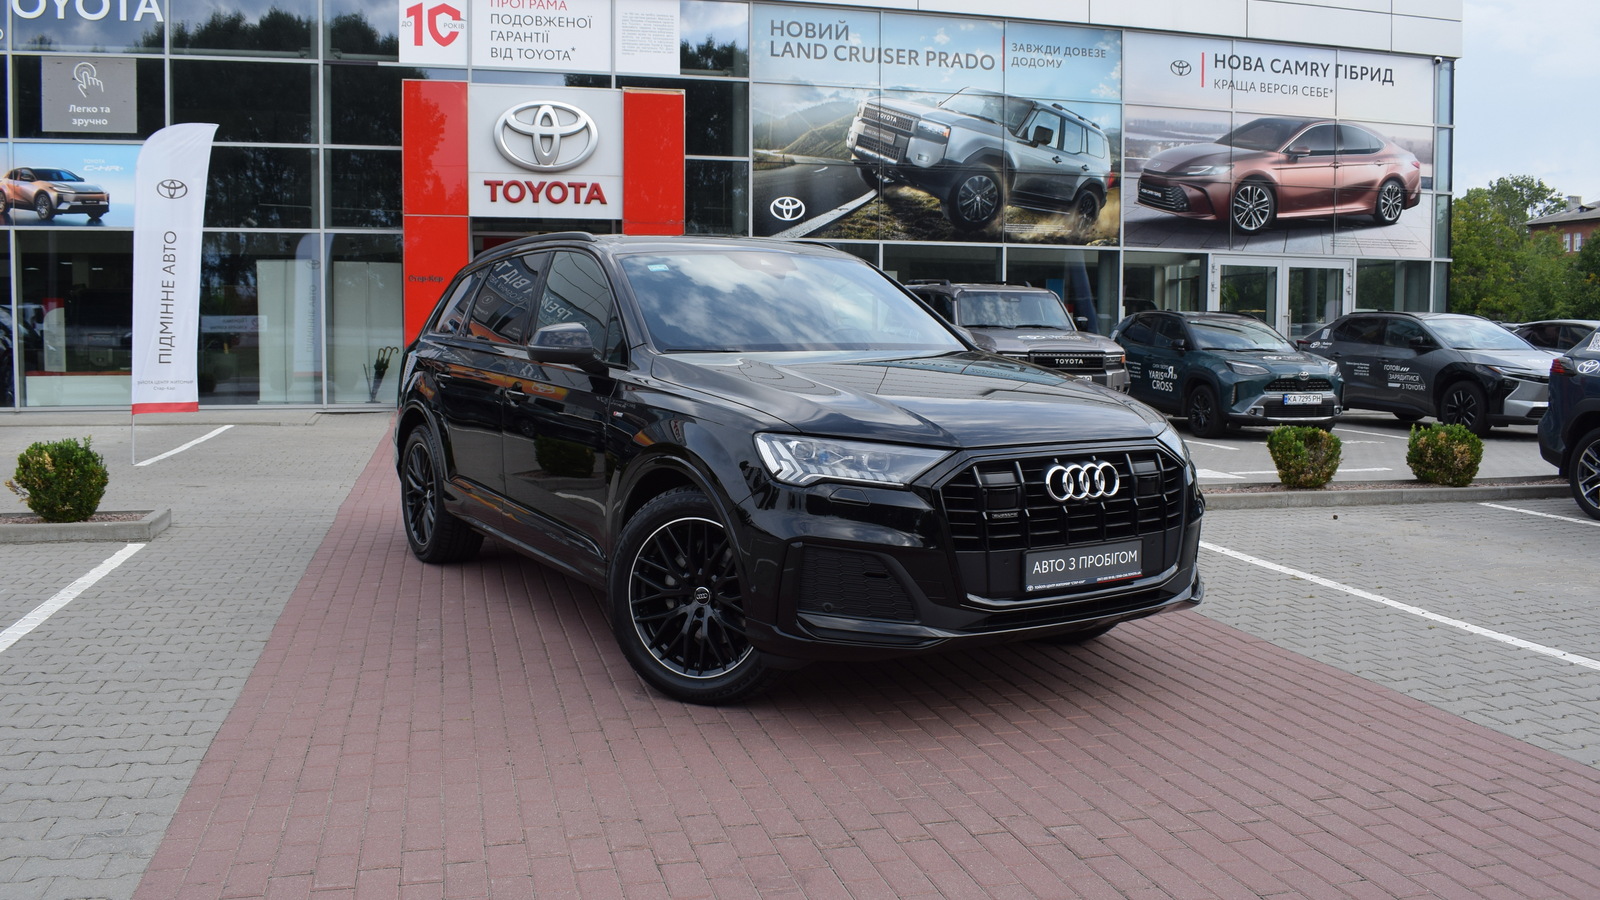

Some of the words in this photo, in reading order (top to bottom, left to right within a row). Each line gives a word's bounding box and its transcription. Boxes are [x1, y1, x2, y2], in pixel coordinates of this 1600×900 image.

[490, 0, 568, 11] ПРОГРАМА
[407, 2, 461, 47] 10
[490, 13, 593, 29] ПОДОВЖЕНОЇ
[490, 30, 551, 43] ГАРАНТІЇ
[770, 19, 850, 41] НОВИЙ
[490, 47, 514, 61] ВІД
[770, 40, 828, 60] LAND
[833, 45, 920, 66] CRUISER
[925, 51, 996, 71] PRADO
[1011, 42, 1062, 57] ЗАВЖДИ
[1063, 46, 1107, 59] ДОВЕЗЕ
[1011, 56, 1063, 69] ДОДОМУ
[1214, 53, 1266, 73] НОВА
[1270, 58, 1331, 78] CAMRY
[1335, 64, 1395, 87] ГІБРИД
[1213, 79, 1257, 93] КРАЩА
[1259, 83, 1299, 96] ВЕРСІЯ
[68, 104, 98, 113] Легко
[72, 118, 108, 126] зручно
[877, 112, 897, 123] TOYOTA
[483, 180, 608, 205] TOYOTA
[162, 230, 177, 276] АВТО
[158, 280, 176, 364] ПІДМІННЕ
[1148, 369, 1164, 380] YARIS
[1388, 373, 1420, 382] ЗАРЯДИТИСЯ
[1151, 379, 1174, 392] CROSS
[1032, 558, 1066, 575] АВТО
[1068, 557, 1076, 571] З
[1079, 549, 1138, 569] ПРОБІГОМ
